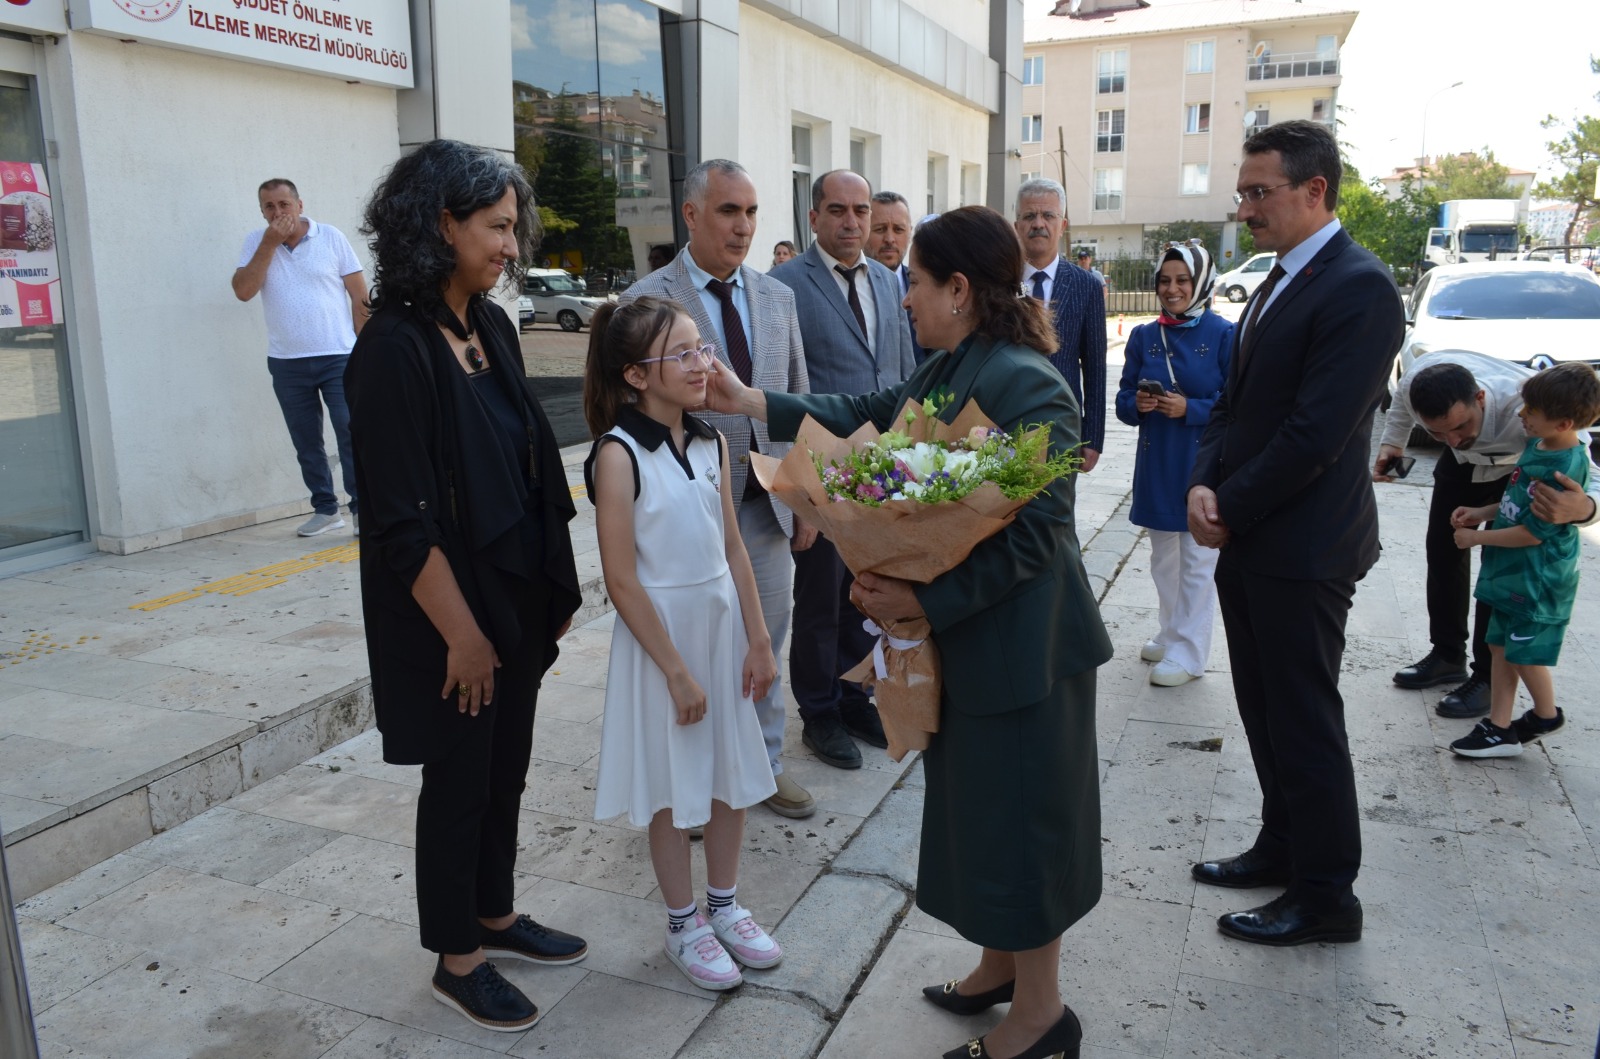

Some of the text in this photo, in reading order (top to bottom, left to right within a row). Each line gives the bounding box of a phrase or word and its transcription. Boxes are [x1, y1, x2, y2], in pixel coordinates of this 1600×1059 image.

[293, 0, 352, 31] ÖNLEME
[355, 18, 373, 36] VE
[189, 4, 408, 70] İZLEME MERKEZİ MÜDÜRLÜĞÜ
[7, 268, 48, 278] YANINDAYIZ
